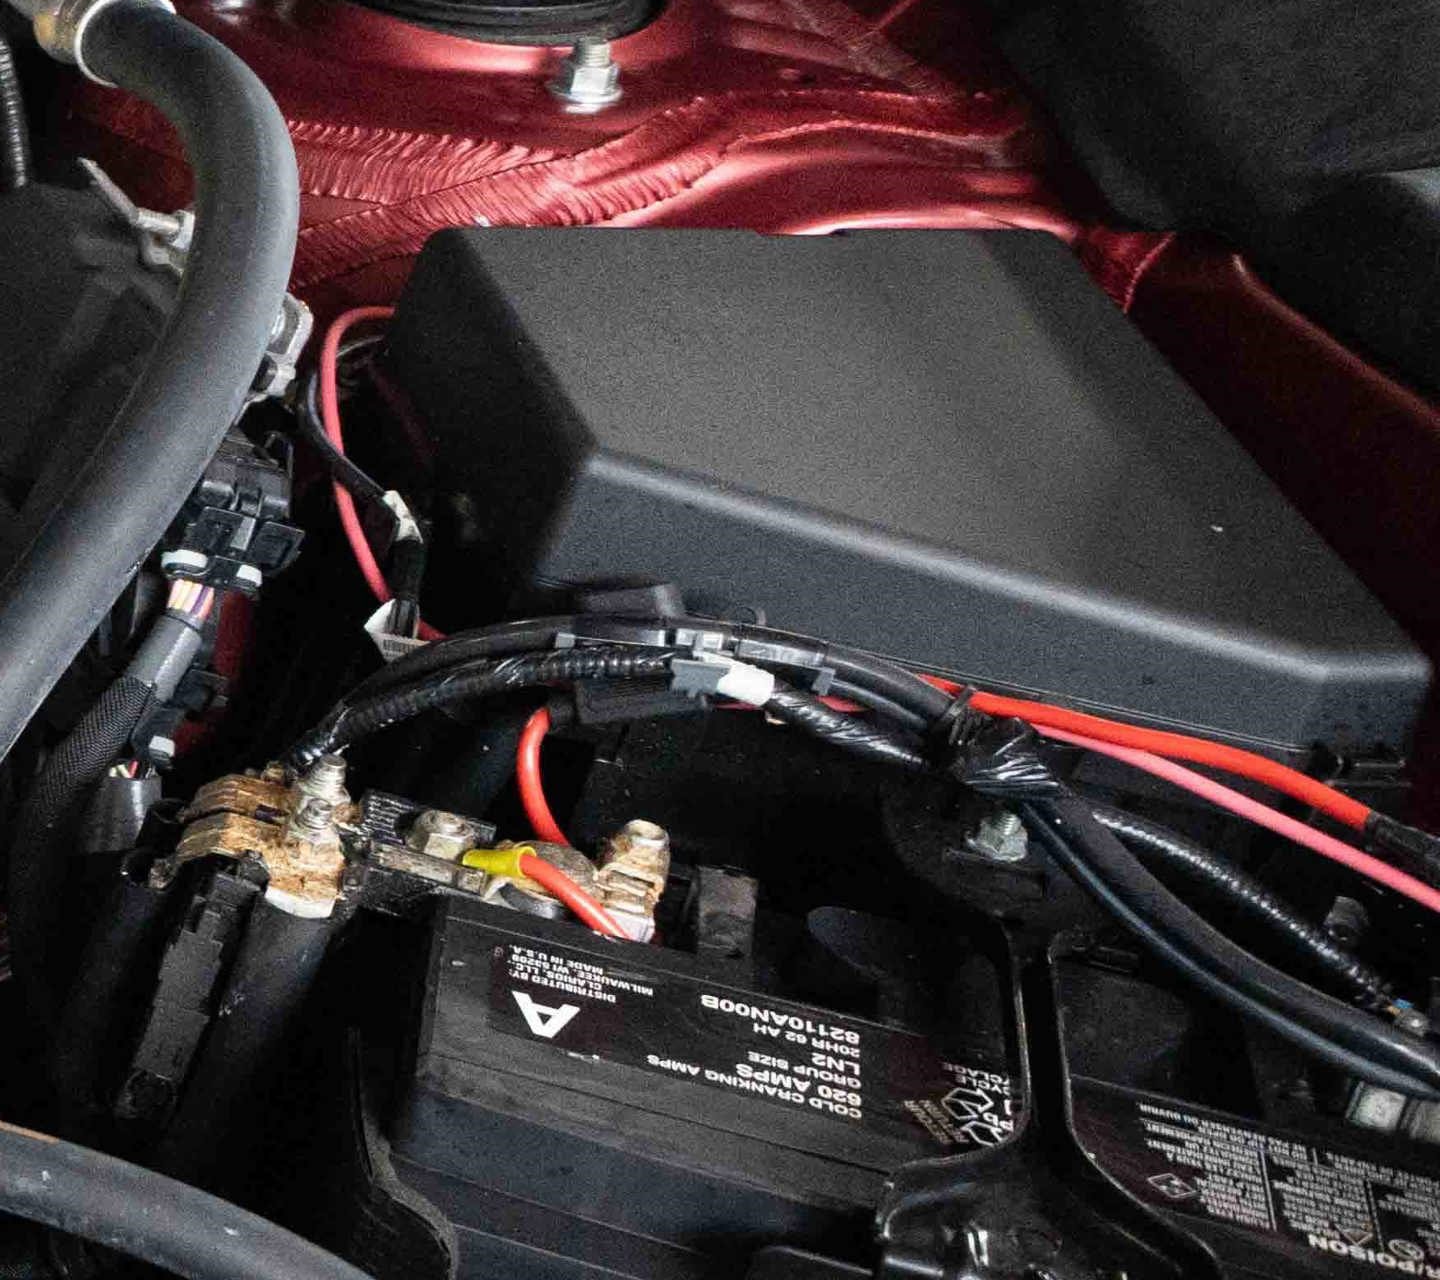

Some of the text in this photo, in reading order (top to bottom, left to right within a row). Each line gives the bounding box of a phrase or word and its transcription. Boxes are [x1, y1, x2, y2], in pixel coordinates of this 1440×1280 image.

[508, 967, 616, 1004] DISTRIBUTED BY:
[552, 963, 569, 974] WI
[700, 990, 860, 1047] 82110AN00B
[752, 1021, 860, 1059] 20HR 62 AH
[747, 1050, 861, 1090] GROUP SIZE
[811, 1050, 860, 1076] LN2
[646, 1053, 862, 1120] COLD CRANKING AMPS
[735, 1061, 861, 1107] 620 AMPS
